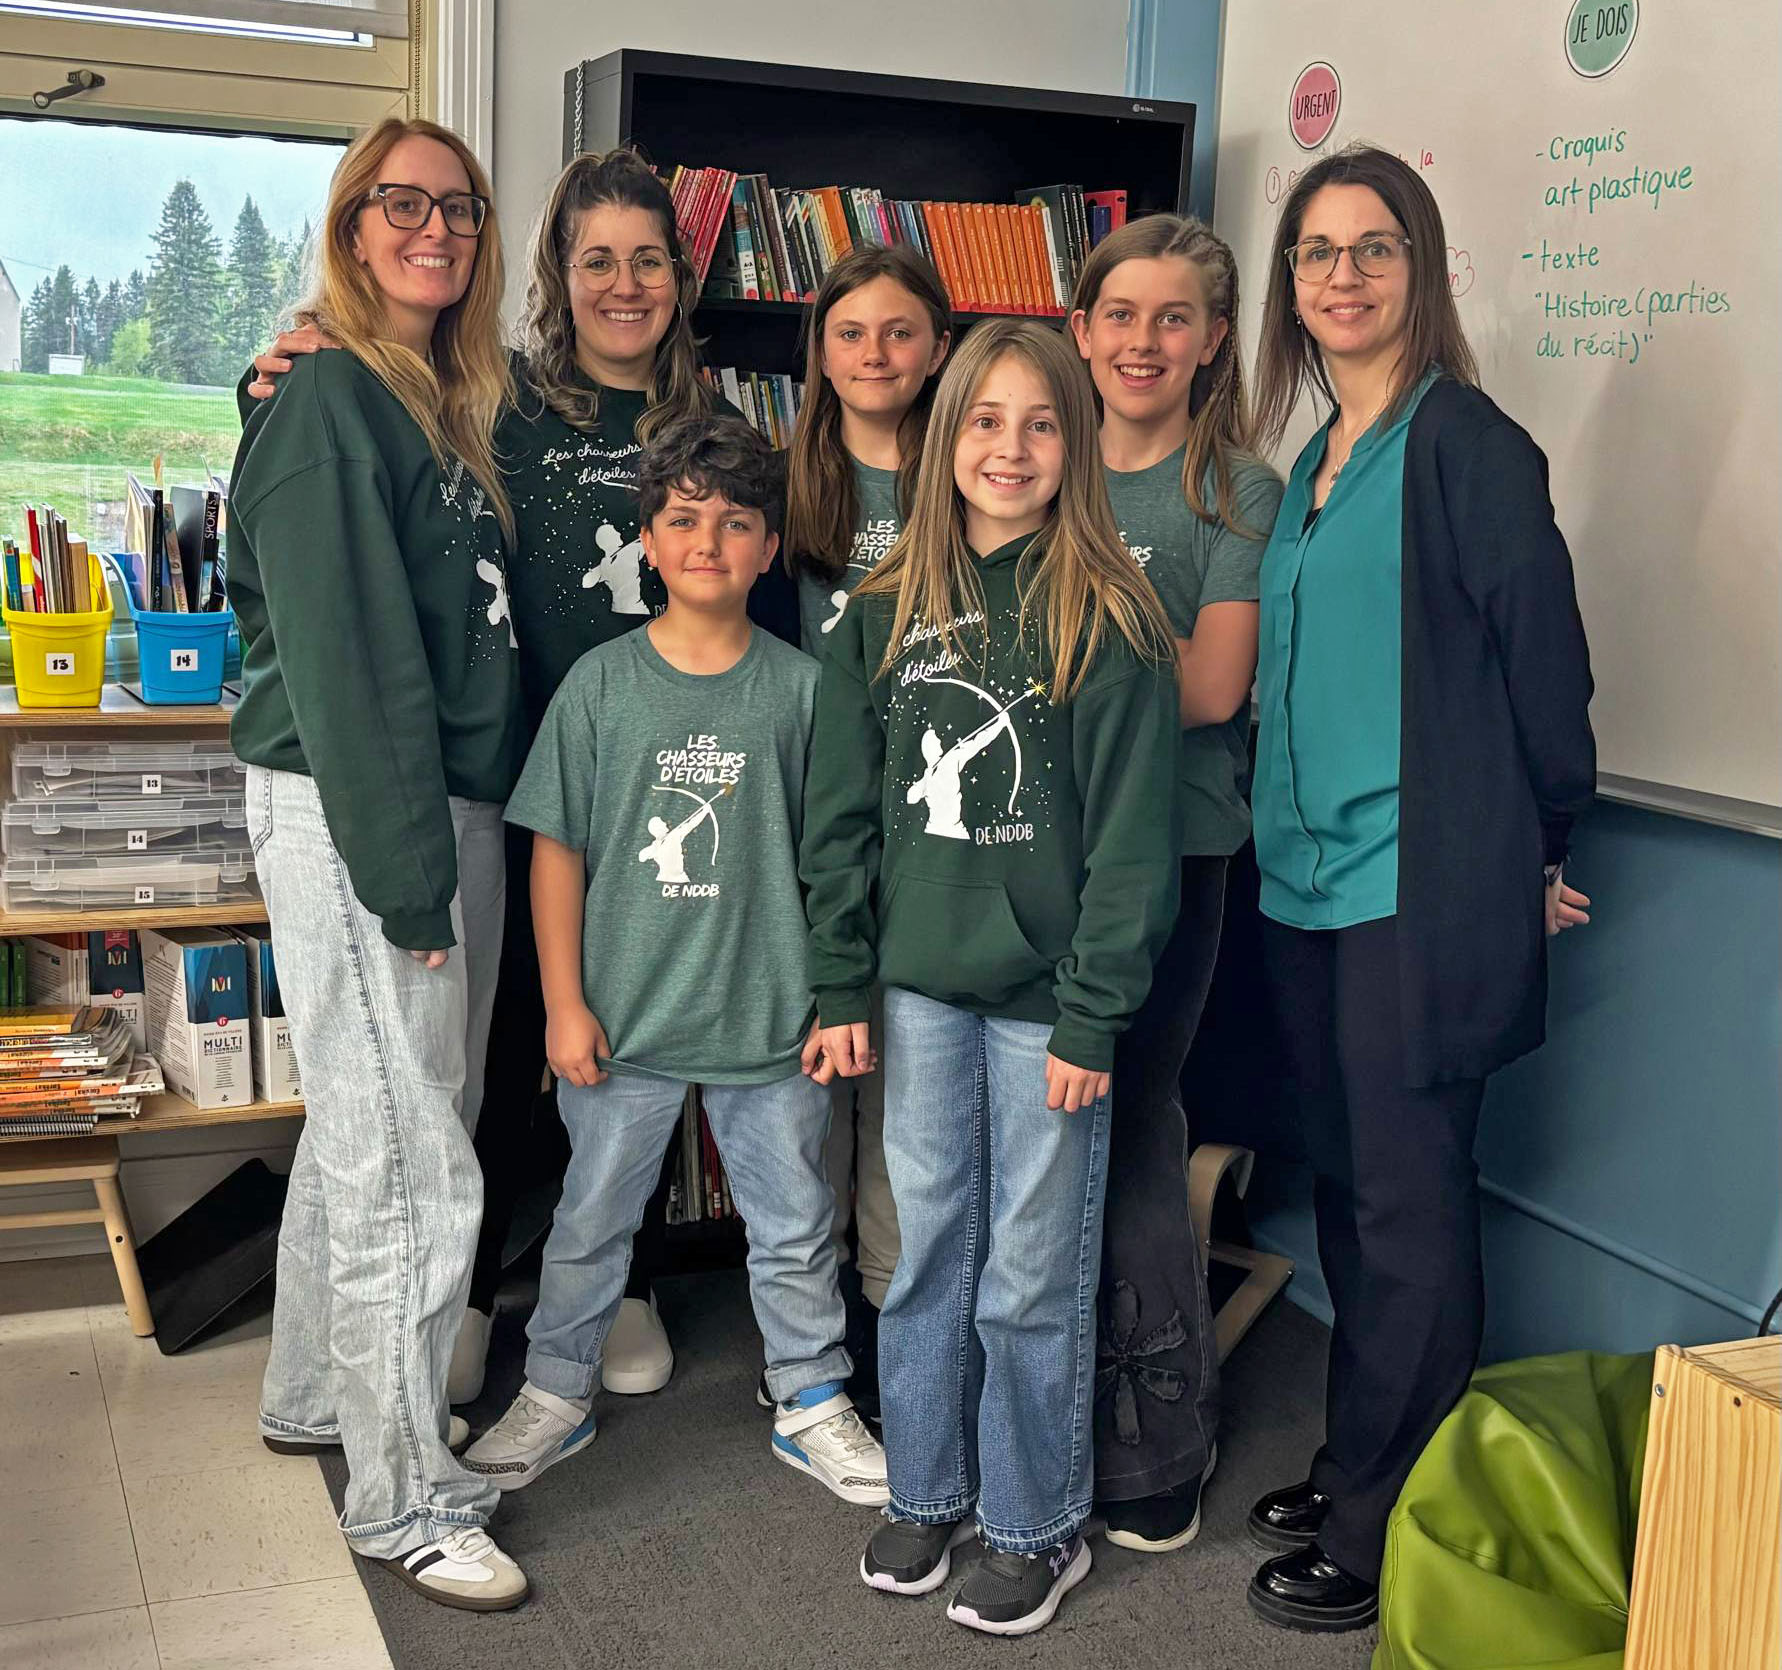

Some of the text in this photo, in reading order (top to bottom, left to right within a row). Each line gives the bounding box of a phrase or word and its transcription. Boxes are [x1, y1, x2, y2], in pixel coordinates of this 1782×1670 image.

[1572, 4, 1628, 44] JE DOIS
[1295, 89, 1337, 121] URGENT
[1550, 128, 1627, 166] Croquis
[1545, 166, 1693, 214] art plastique
[1541, 239, 1599, 272] texte
[1537, 332, 1564, 357] du
[542, 448, 573, 465] Les
[579, 466, 636, 485] d'étoiles
[204, 499, 217, 540] SPORTS
[867, 519, 896, 533] LES
[902, 611, 984, 646] chaseurs
[52, 659, 69, 670] 13
[176, 655, 191, 667] 14
[901, 650, 962, 687] d'étoiles
[687, 734, 719, 750] LES
[656, 750, 747, 769] CHASSEURS
[146, 779, 158, 788] 13
[131, 835, 143, 844] 14
[976, 823, 1034, 845] DE NDDB
[139, 891, 150, 900] 15
[662, 884, 720, 898] DE NDDB
[203, 1035, 242, 1049] MULTI
